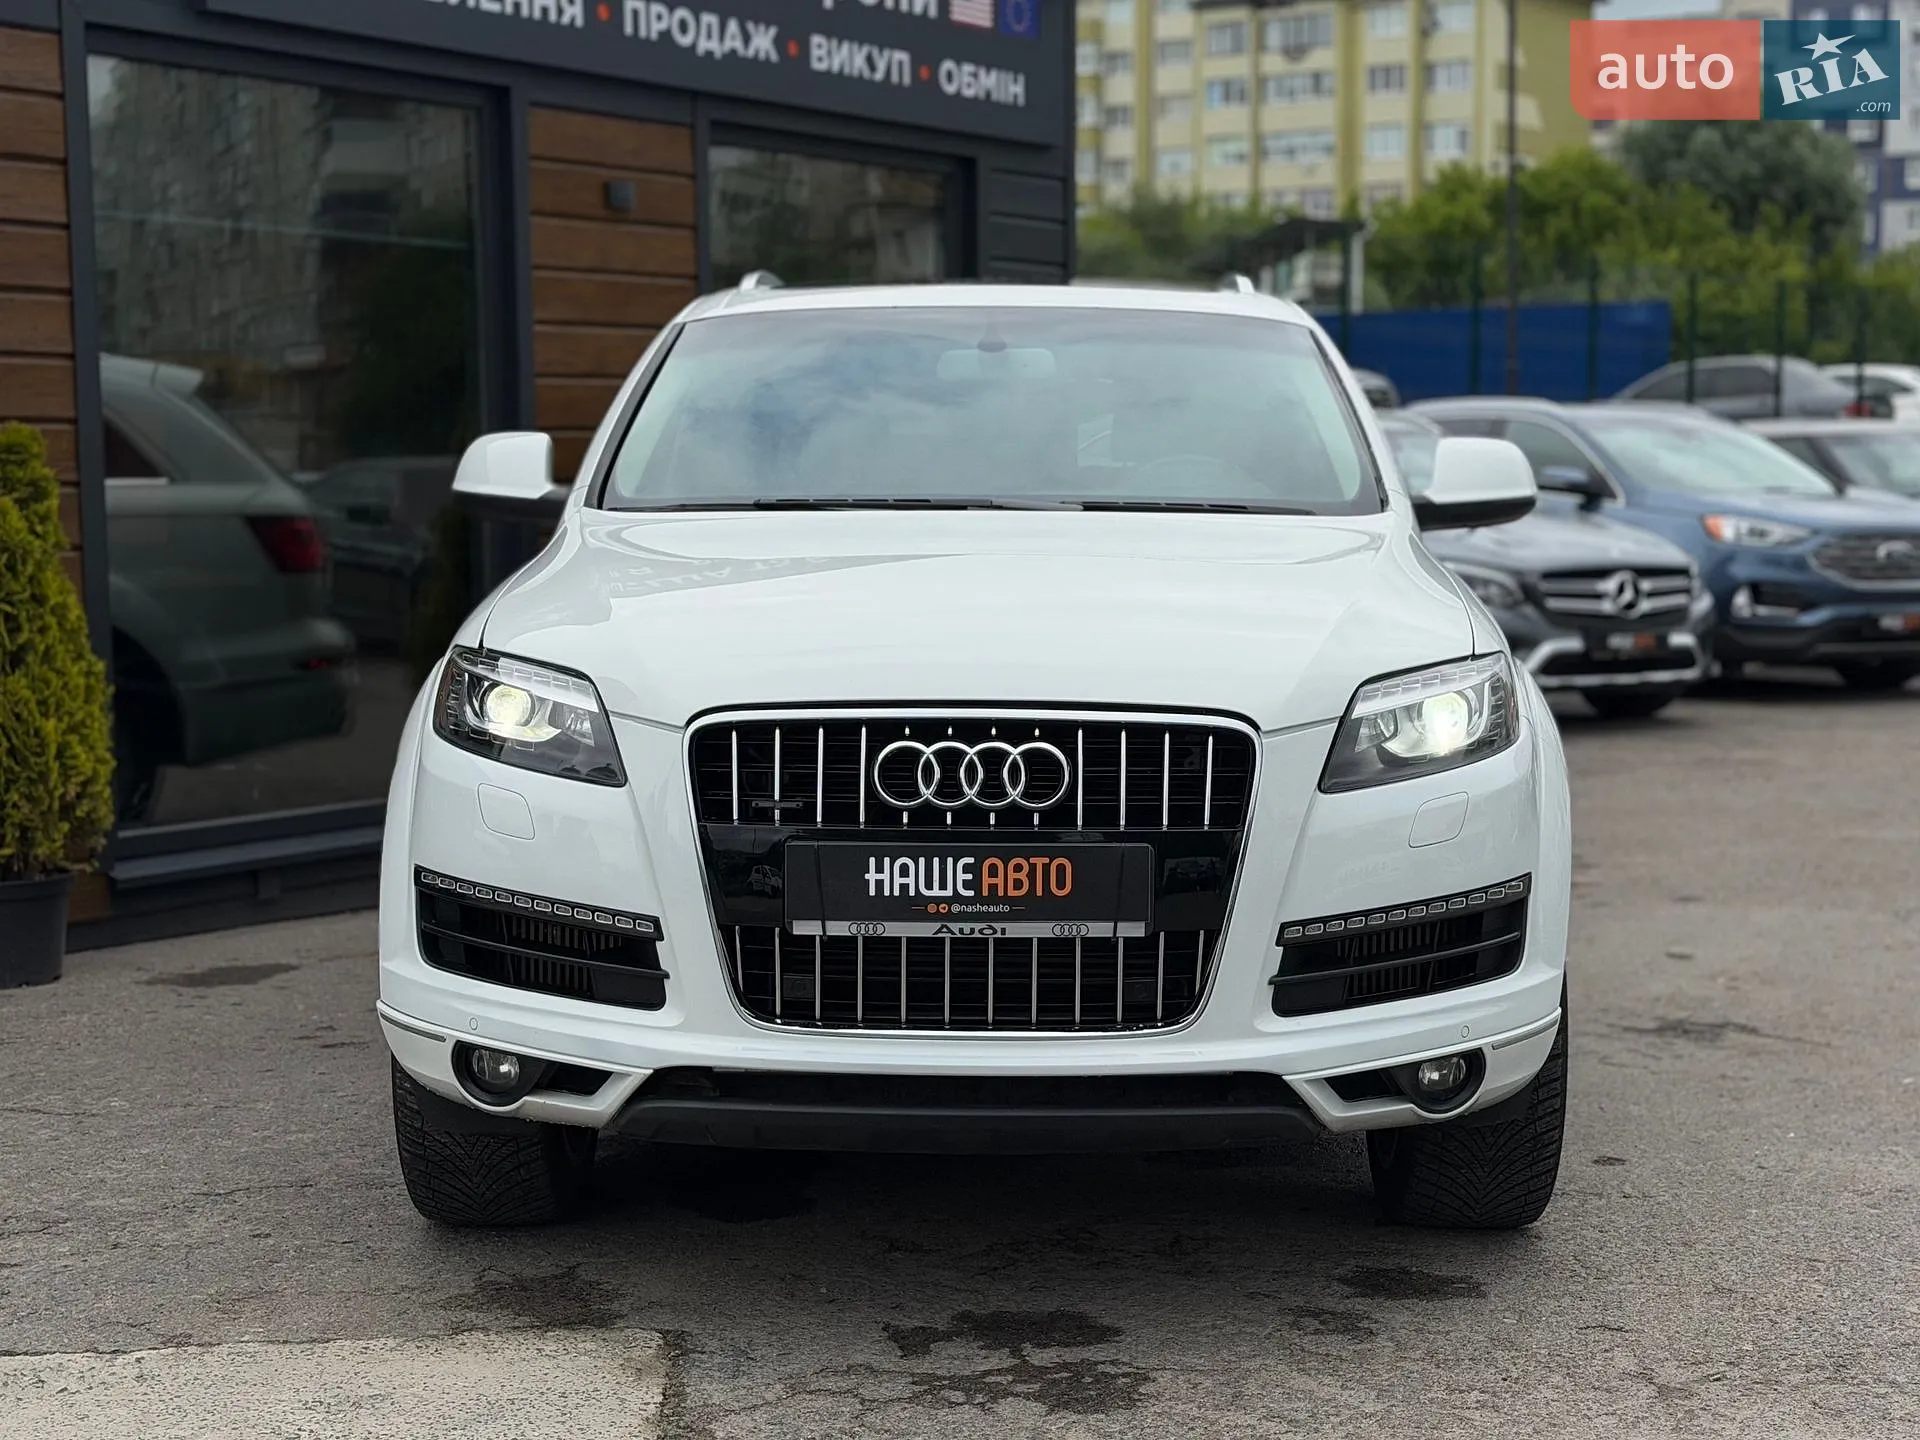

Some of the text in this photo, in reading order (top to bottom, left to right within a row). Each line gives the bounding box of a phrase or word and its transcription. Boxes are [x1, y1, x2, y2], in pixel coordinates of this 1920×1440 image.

[623, 0, 780, 63] ПРОДАЖ
[809, 33, 912, 88] ВИКУП
[937, 58, 1026, 107] ОБМІН
[864, 856, 1073, 897] НАШЕ АВТО
[951, 903, 1010, 914] @nasheauto
[932, 924, 1007, 936] Audi
